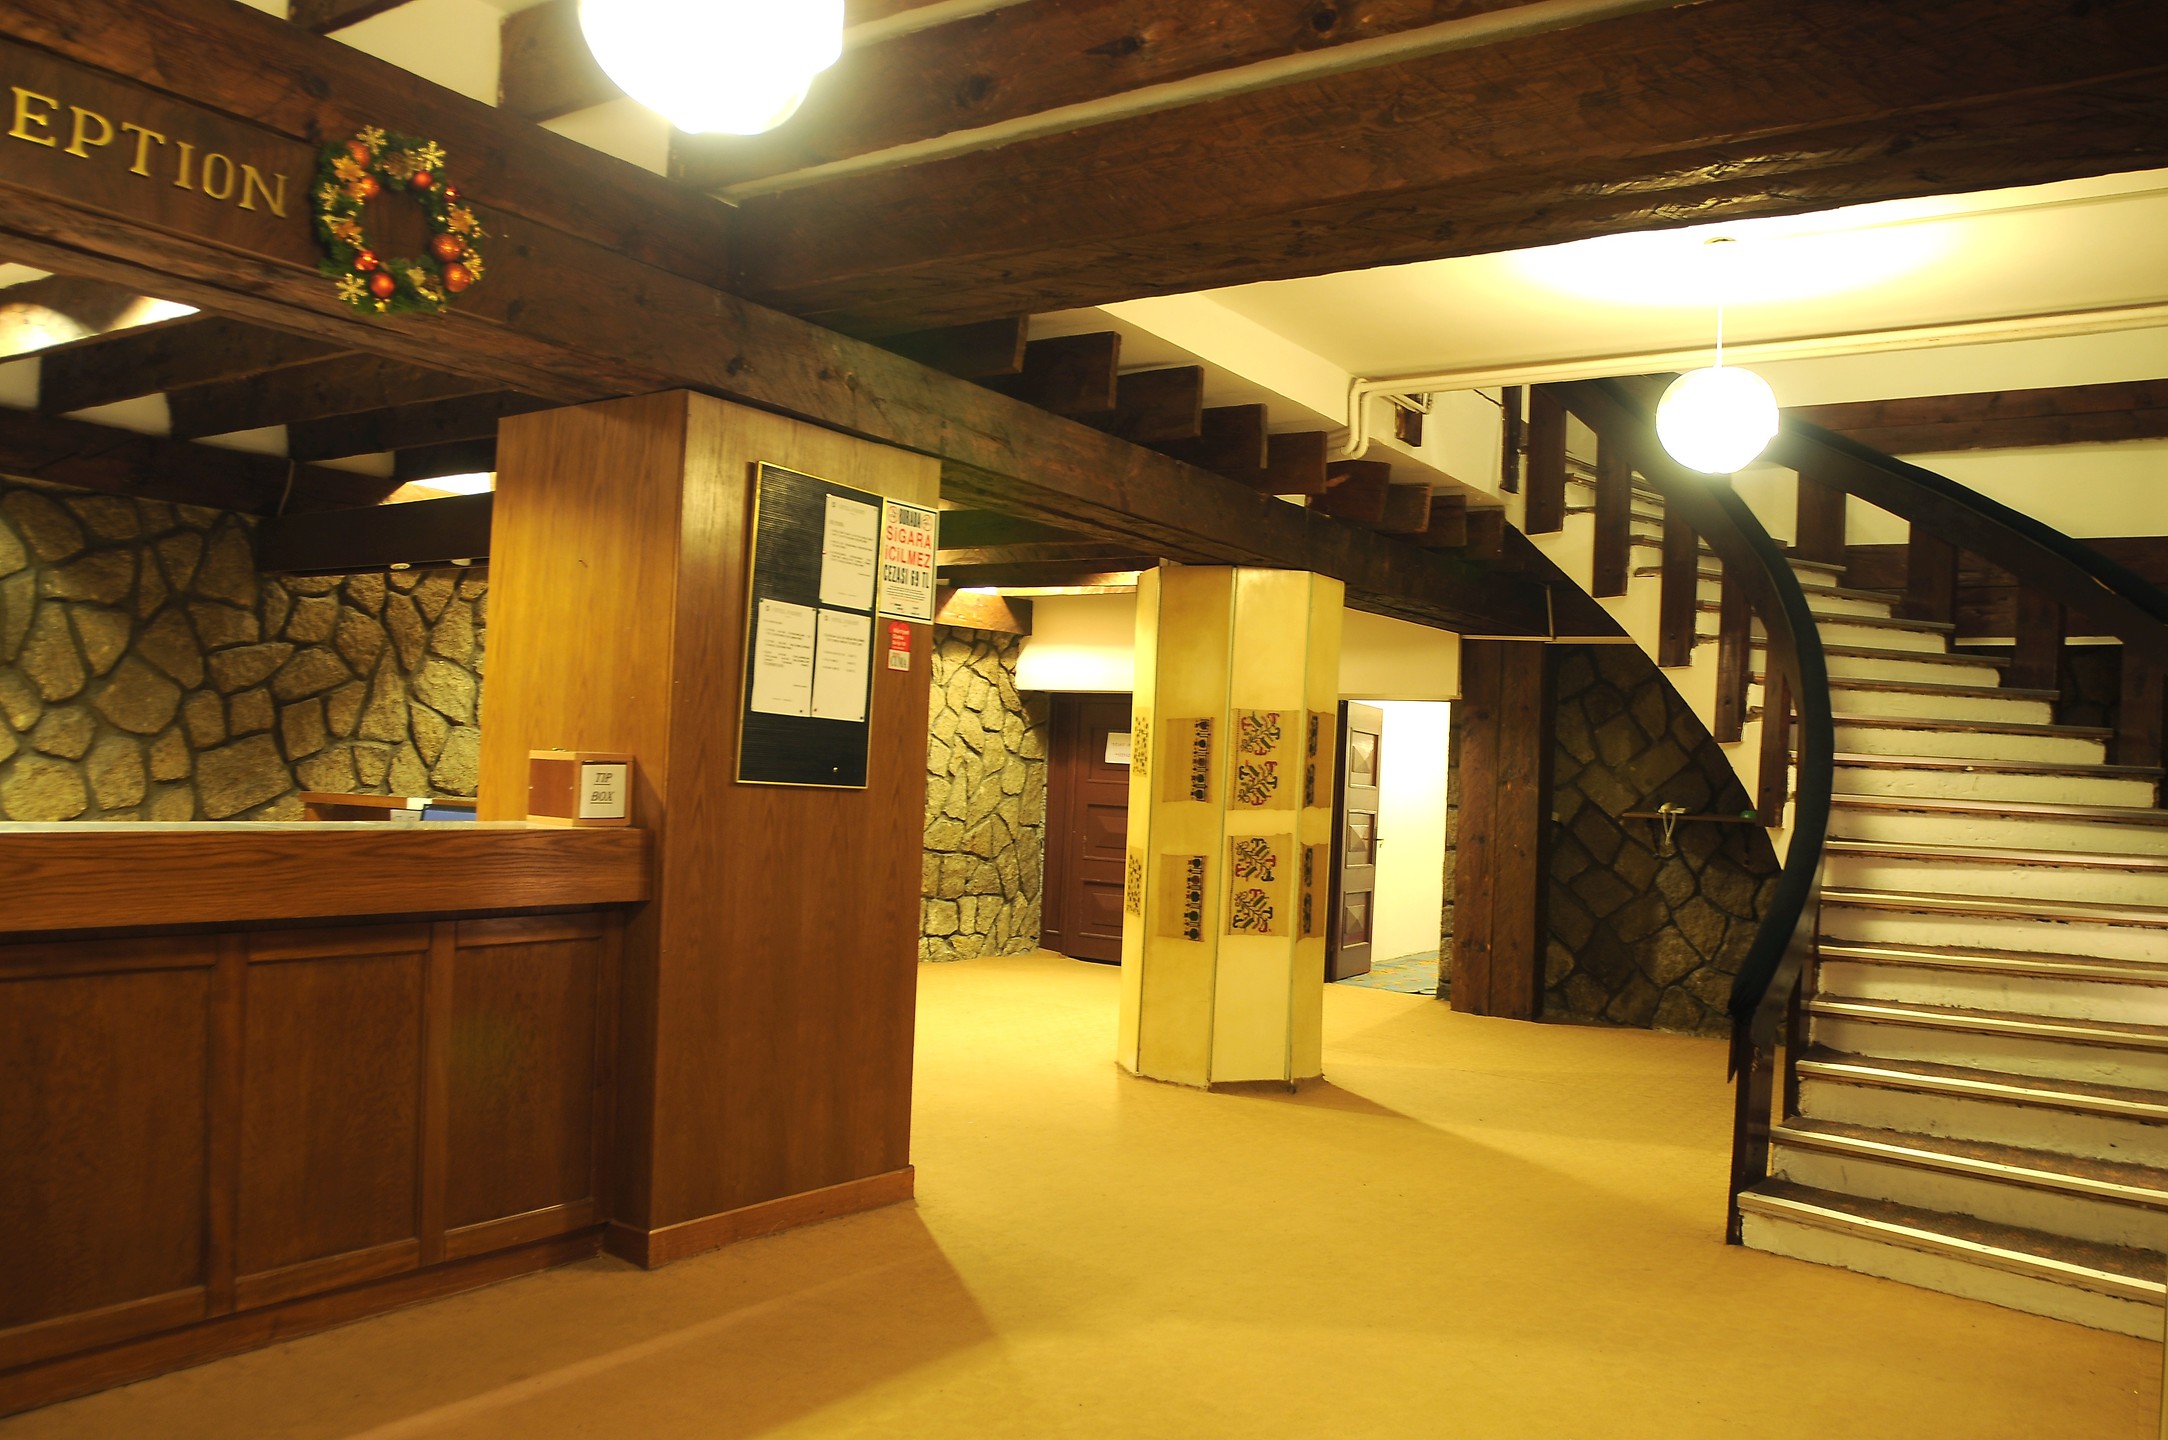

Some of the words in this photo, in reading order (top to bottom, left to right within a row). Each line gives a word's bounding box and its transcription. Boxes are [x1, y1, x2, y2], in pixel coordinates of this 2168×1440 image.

[8, 86, 289, 219] EPTION
[595, 772, 613, 783] TIP
[590, 791, 615, 802] BOX
